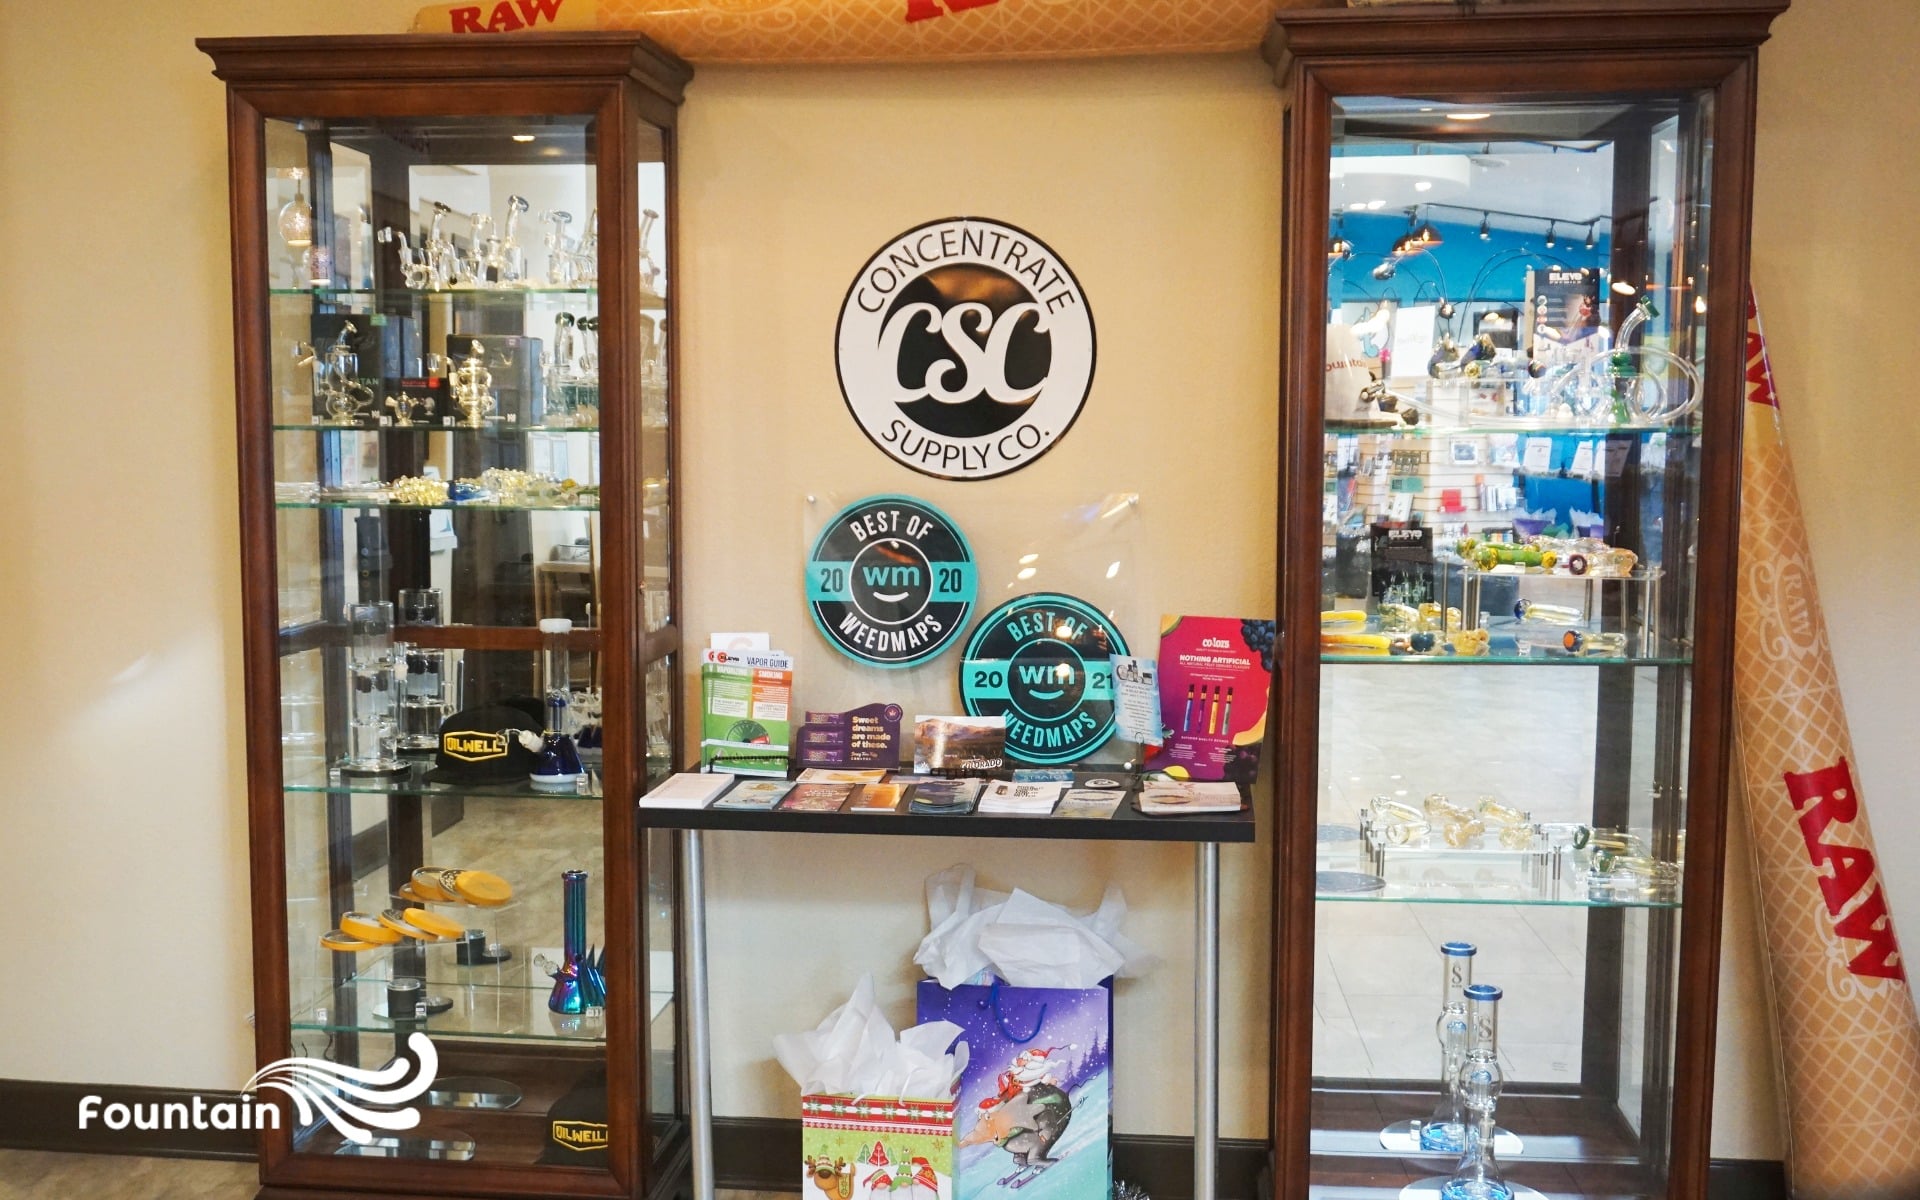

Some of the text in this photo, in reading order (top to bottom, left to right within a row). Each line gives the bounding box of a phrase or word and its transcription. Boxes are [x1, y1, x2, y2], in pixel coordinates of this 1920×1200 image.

[449, 0, 563, 33] RAW
[857, 228, 1075, 315] CONCENTRATE
[876, 301, 1053, 404] CSC
[881, 419, 1051, 470] SUPPLY CO.
[850, 510, 934, 543] BEST OF
[820, 564, 962, 594] 20 wm 20
[838, 611, 943, 653] WEEDMAPS
[1006, 611, 1088, 643] BEST OF
[746, 656, 768, 667] VAPOR
[769, 658, 789, 668] GUIDE
[1180, 654, 1251, 666] NOTHING ARTIFICIAL
[974, 671, 1003, 689] 20
[1019, 664, 1075, 685] wm
[1092, 672, 1114, 689] 21
[852, 716, 879, 724] Sweet
[852, 724, 884, 732] dreams
[1001, 708, 1097, 748] WEEDMAPS
[446, 737, 503, 753] OILWELL
[862, 740, 888, 749] these.
[867, 732, 891, 741] made
[1784, 755, 1906, 983] RAW
[555, 1125, 606, 1143] OILWELL
